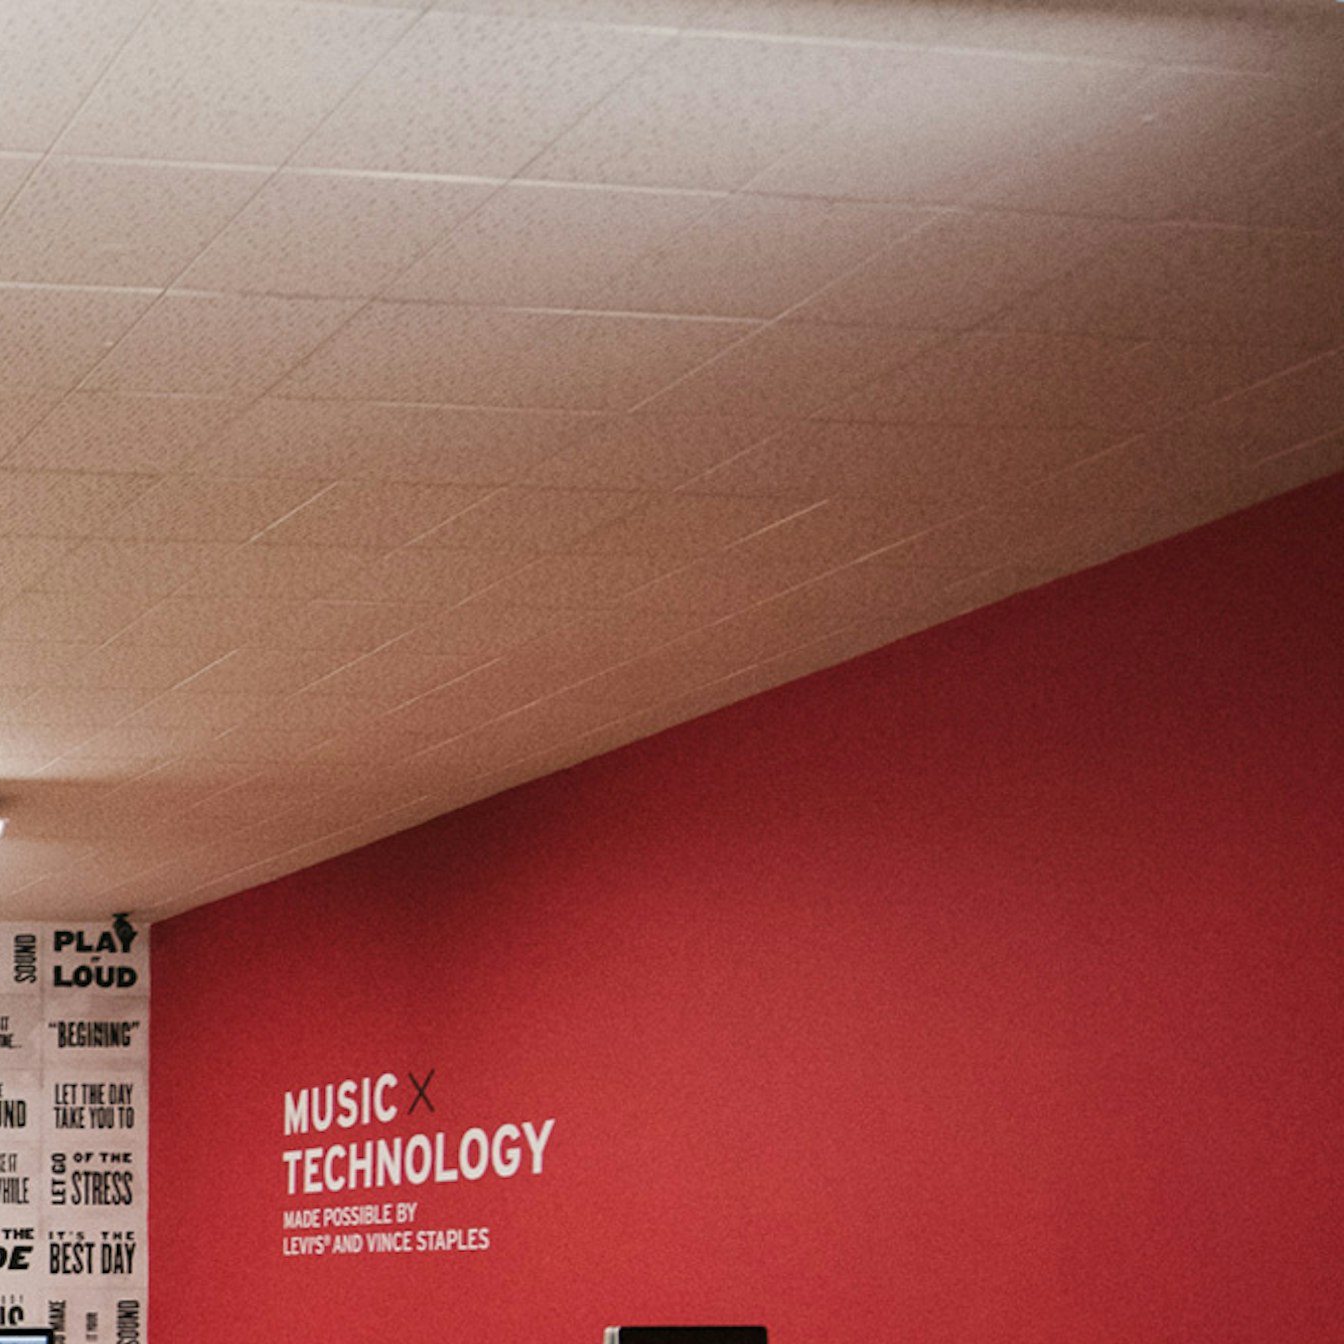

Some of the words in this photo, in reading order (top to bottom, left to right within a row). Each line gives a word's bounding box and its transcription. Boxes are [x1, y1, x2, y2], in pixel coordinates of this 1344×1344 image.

[53, 931, 138, 953] PLAY
[13, 933, 38, 984] SOUND
[53, 964, 138, 989] LOUD
[284, 1073, 398, 1136] MUSIC
[283, 1119, 555, 1194] TECHNOLOGY
[71, 1170, 134, 1206] STRESS
[283, 1208, 321, 1229] MADE
[323, 1203, 393, 1226] POSSIBLE
[396, 1202, 418, 1222] BY
[333, 1233, 363, 1253] AND
[366, 1231, 412, 1252] VINCE
[416, 1228, 490, 1251] STAPLES
